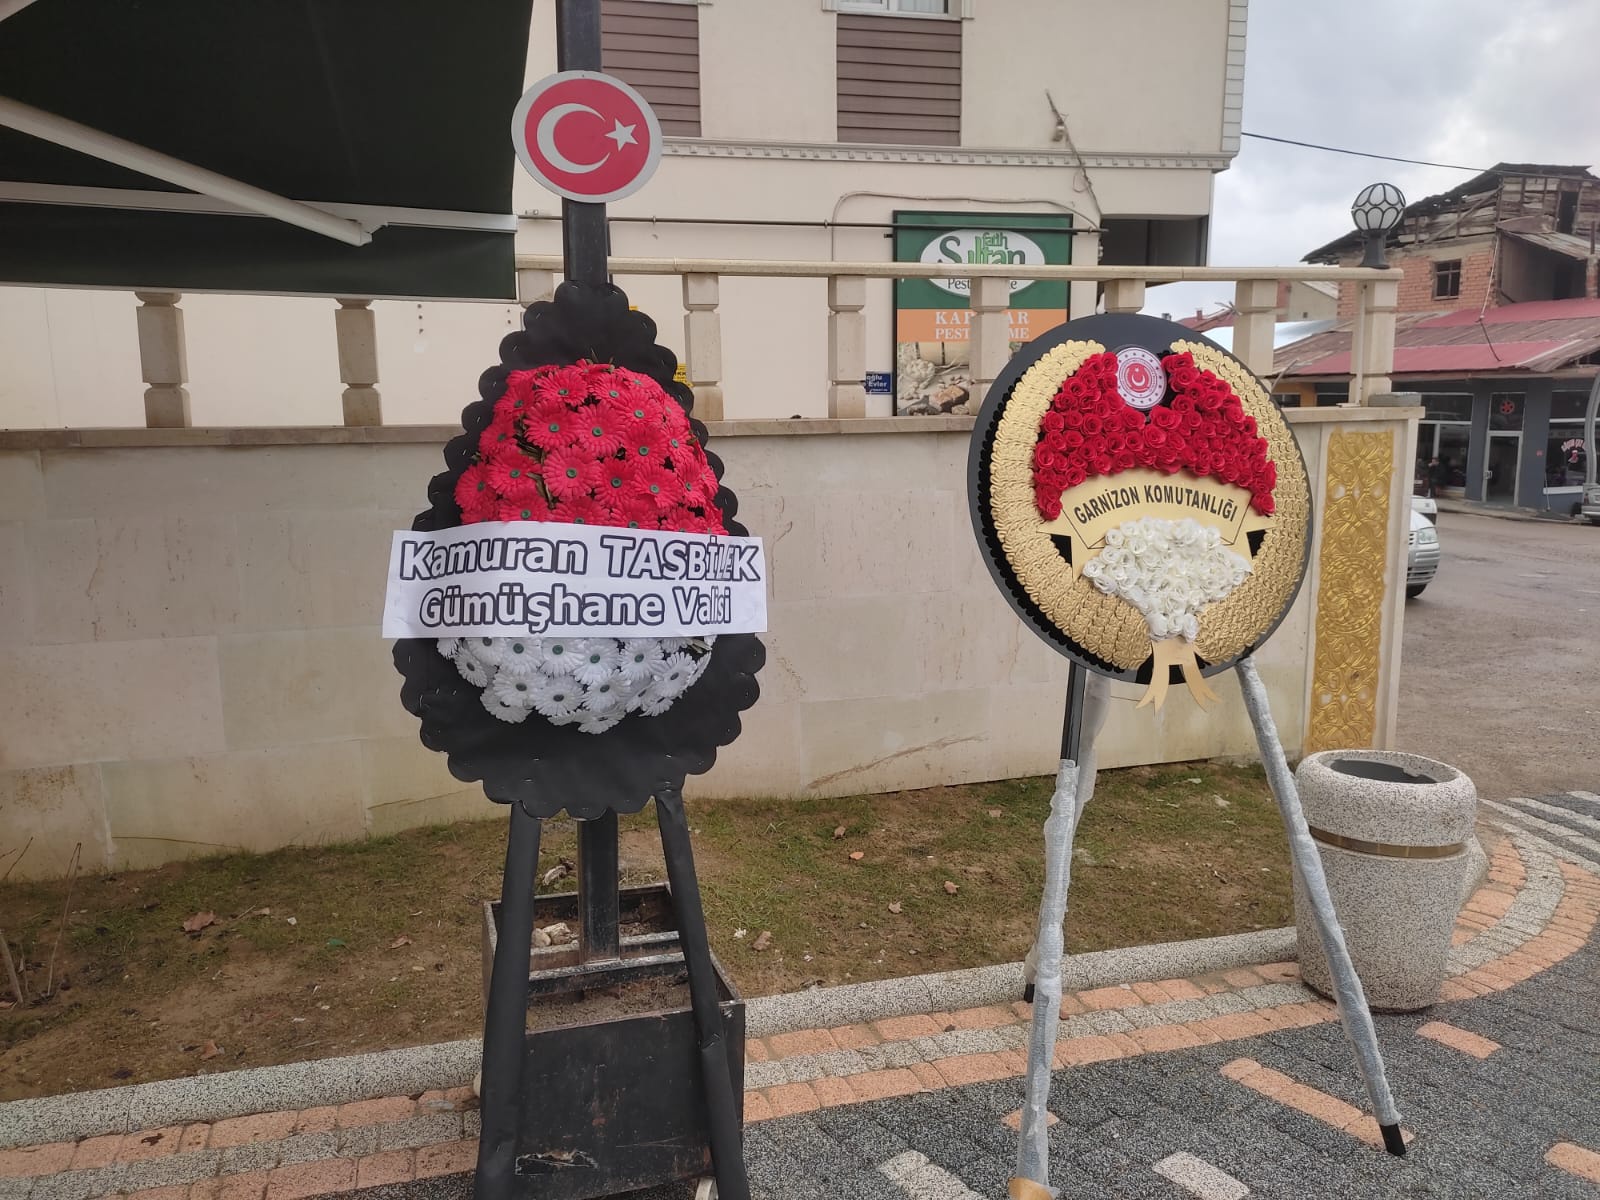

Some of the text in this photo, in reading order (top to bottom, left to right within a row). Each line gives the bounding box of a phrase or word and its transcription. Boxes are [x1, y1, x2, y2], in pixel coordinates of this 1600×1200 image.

[1073, 484, 1238, 524] GARNİZON KOMUTANLIĞI
[400, 537, 588, 581] Kamuran
[419, 583, 731, 634] Gümüşhane Valisi
